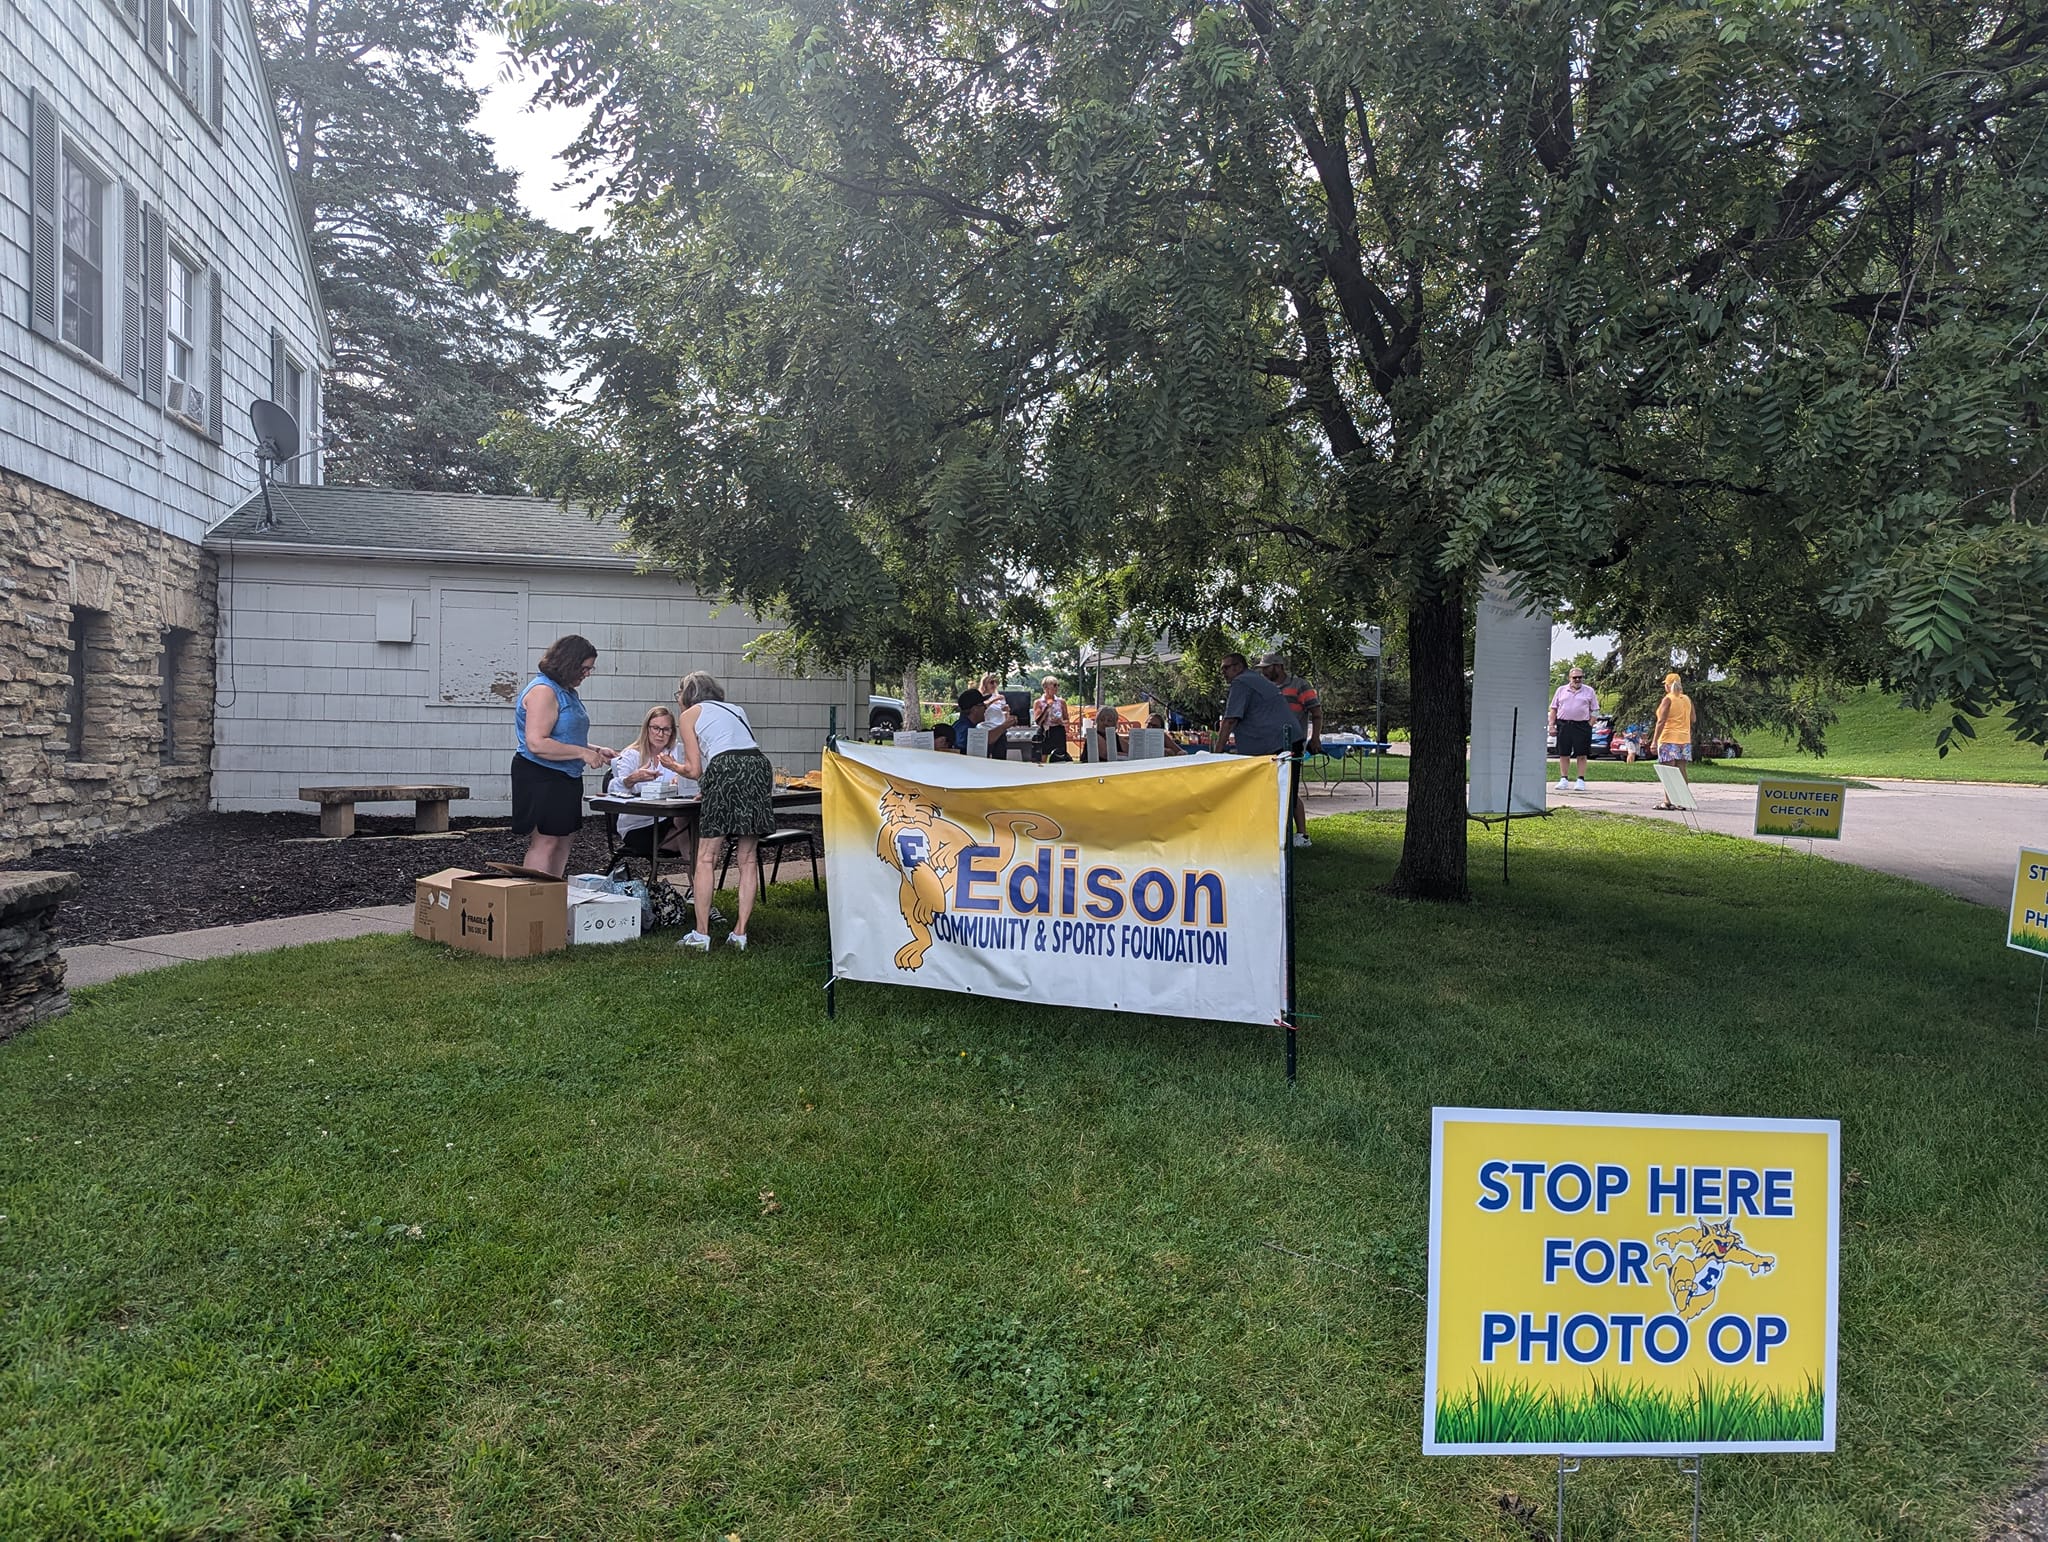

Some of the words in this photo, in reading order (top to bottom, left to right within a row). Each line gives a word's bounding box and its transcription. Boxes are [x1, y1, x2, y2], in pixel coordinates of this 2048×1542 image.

[1765, 789, 1839, 802] VOLUNTEER
[1770, 805, 1829, 817] CHECK-IN
[897, 835, 925, 868] E
[953, 844, 1227, 927] Edison
[467, 914, 487, 925] FRAGILE
[933, 912, 1030, 951] COMMUNITY
[1034, 923, 1047, 952] &
[1052, 920, 1116, 958] SPORTS
[1121, 925, 1228, 966] FOUNDATION
[1477, 1160, 1630, 1213] STOP
[1649, 1166, 1795, 1217] HERE
[1544, 1238, 1650, 1285] FOR
[1699, 1266, 1720, 1293] E
[1480, 1312, 1690, 1364] PHOTO
[1706, 1313, 1789, 1364] OP
